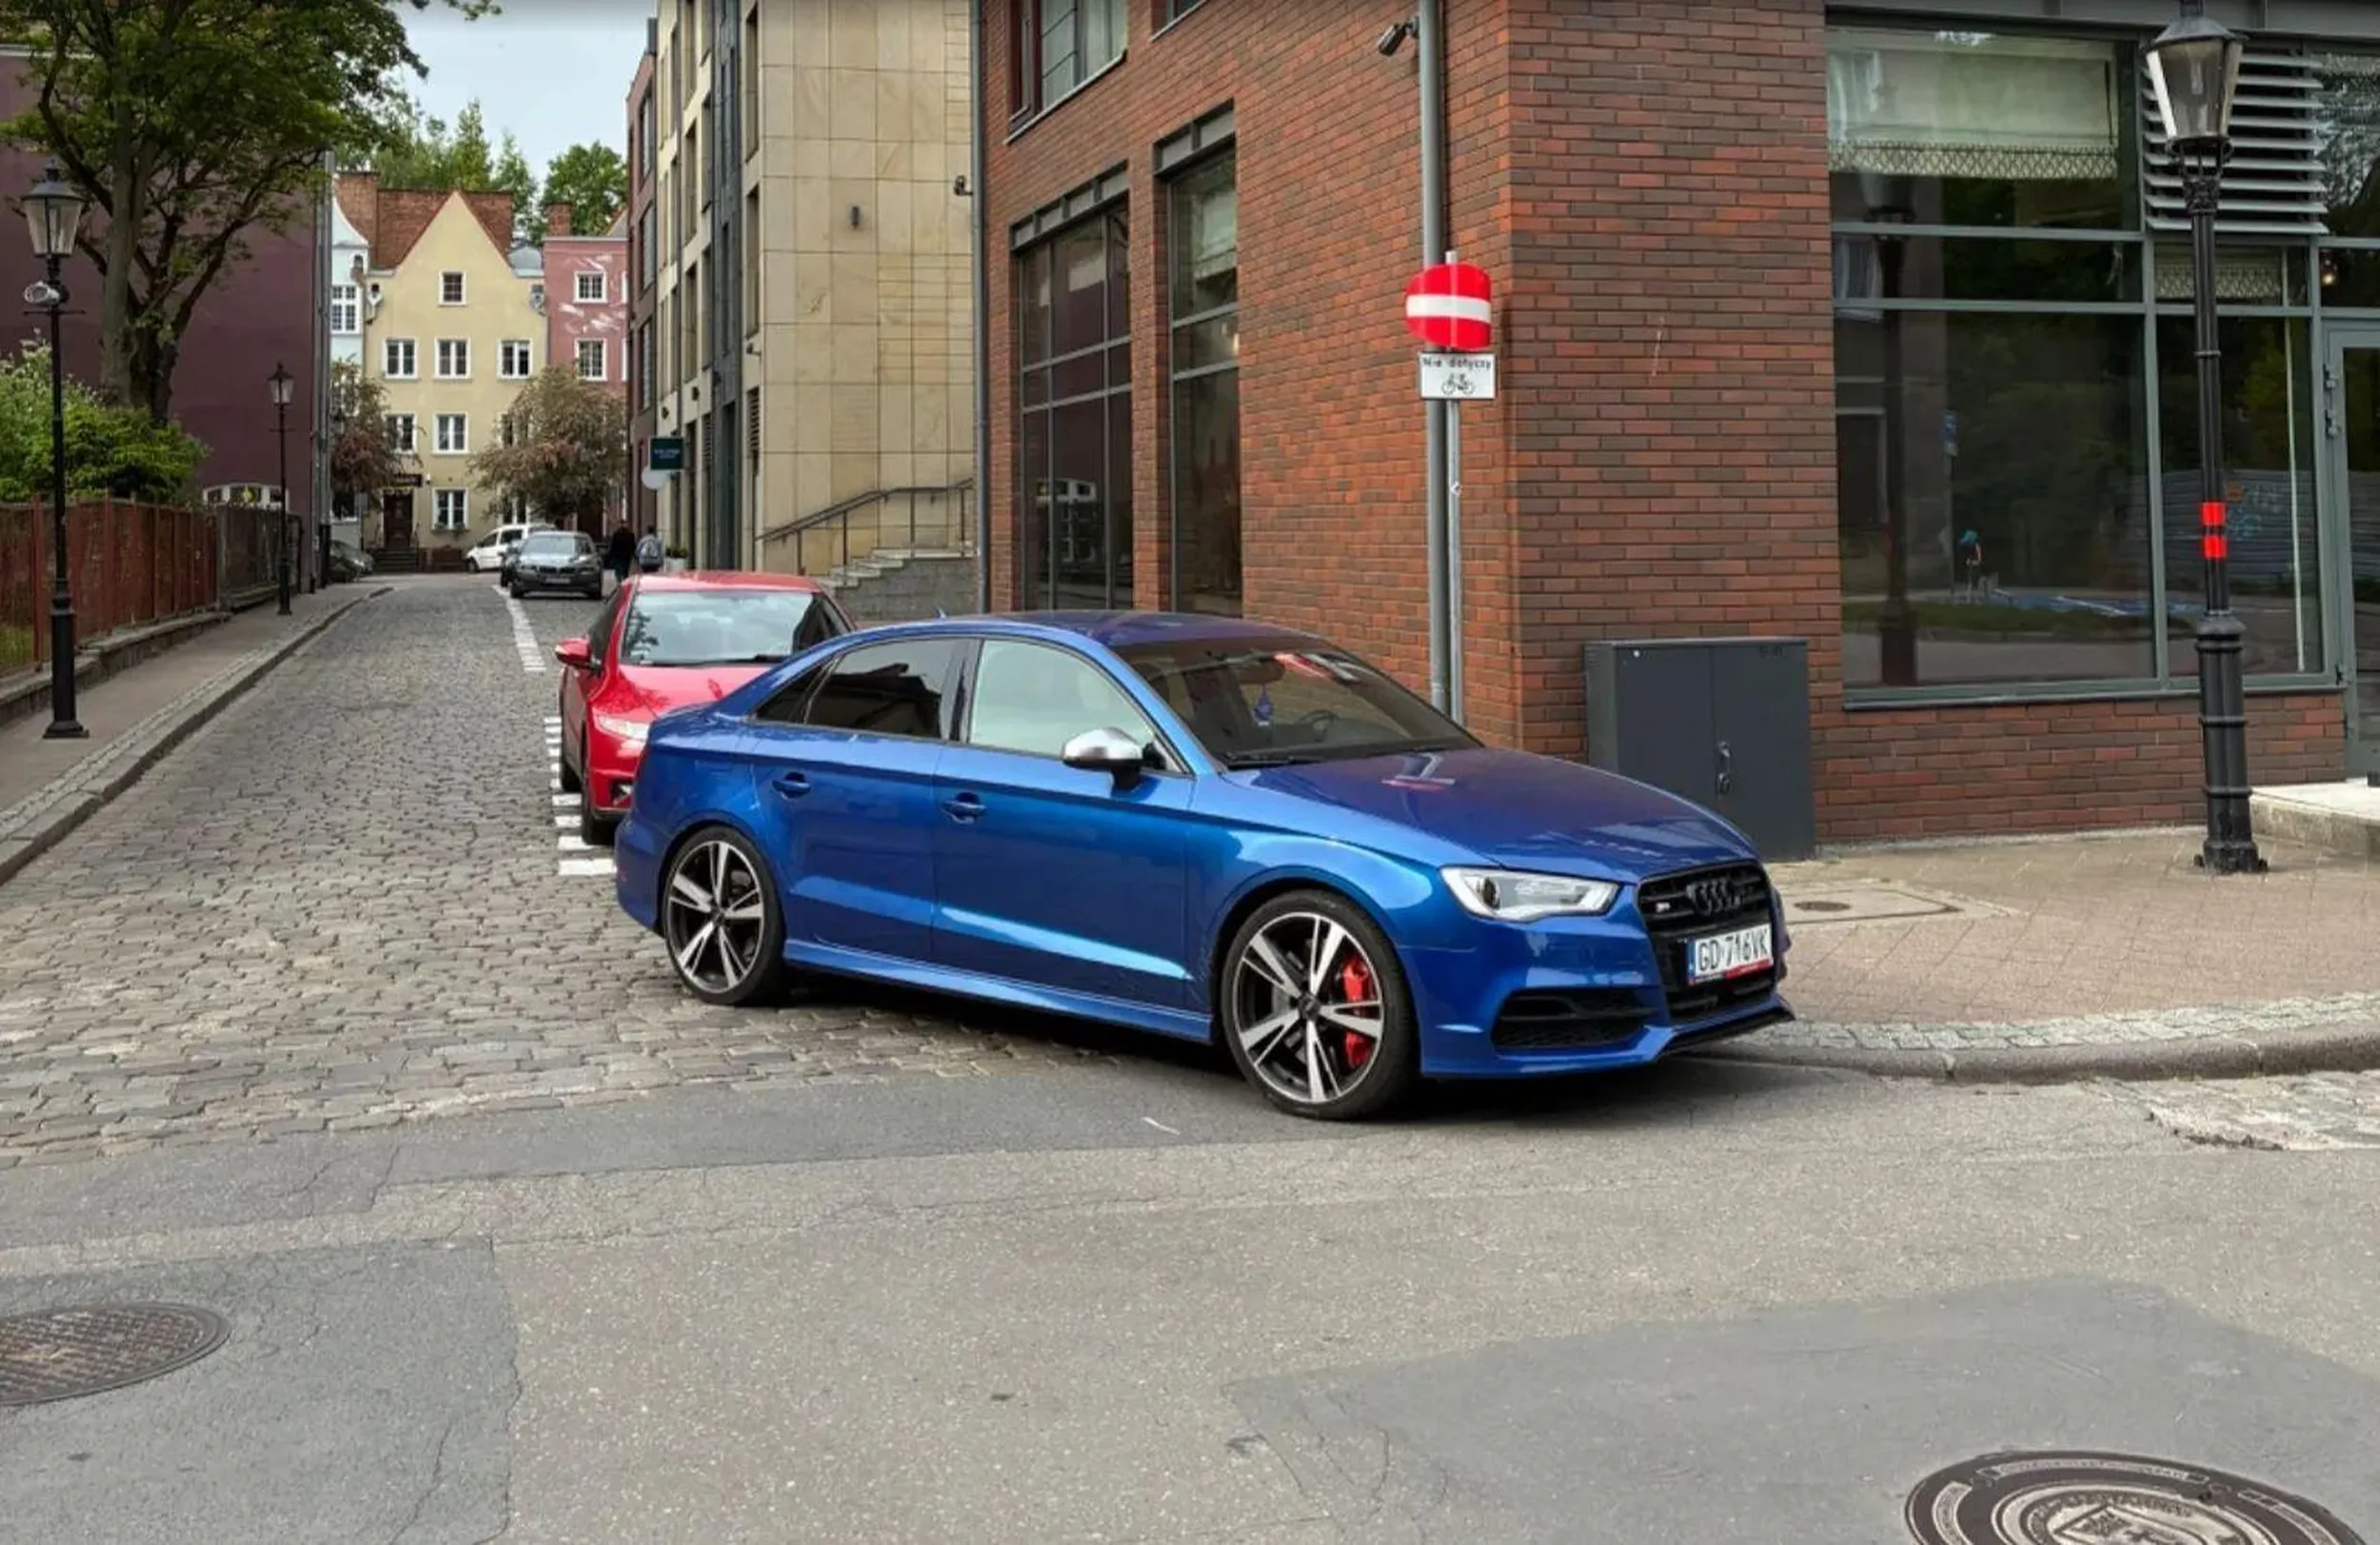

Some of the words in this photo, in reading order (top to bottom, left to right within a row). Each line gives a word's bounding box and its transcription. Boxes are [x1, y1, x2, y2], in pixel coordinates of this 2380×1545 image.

[1423, 357, 1440, 366] Nie
[1450, 357, 1491, 369] dotyczy
[1699, 940, 1720, 971] GD
